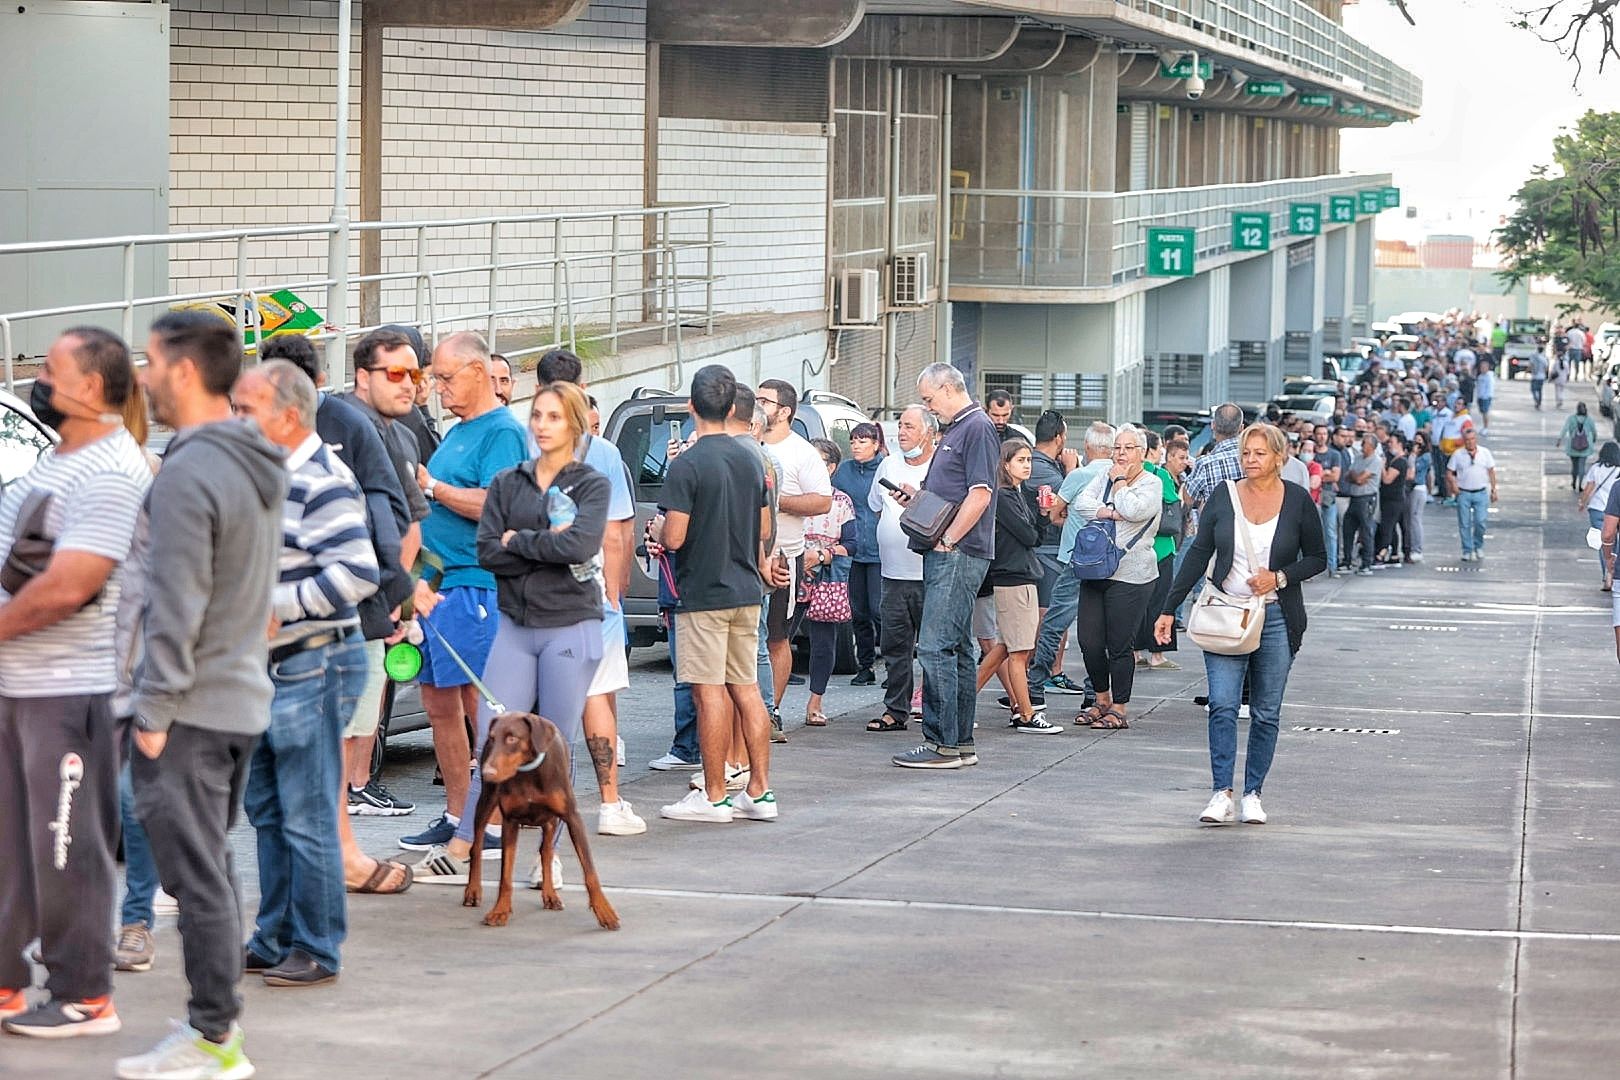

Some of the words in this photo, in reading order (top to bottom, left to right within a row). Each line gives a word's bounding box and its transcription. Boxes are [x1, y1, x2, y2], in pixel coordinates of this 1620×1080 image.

[1335, 207, 1351, 220] 14
[1296, 216, 1314, 231] 13
[1157, 234, 1185, 242] PUERTA
[1241, 228, 1262, 246] 12
[1160, 248, 1182, 270] 11
